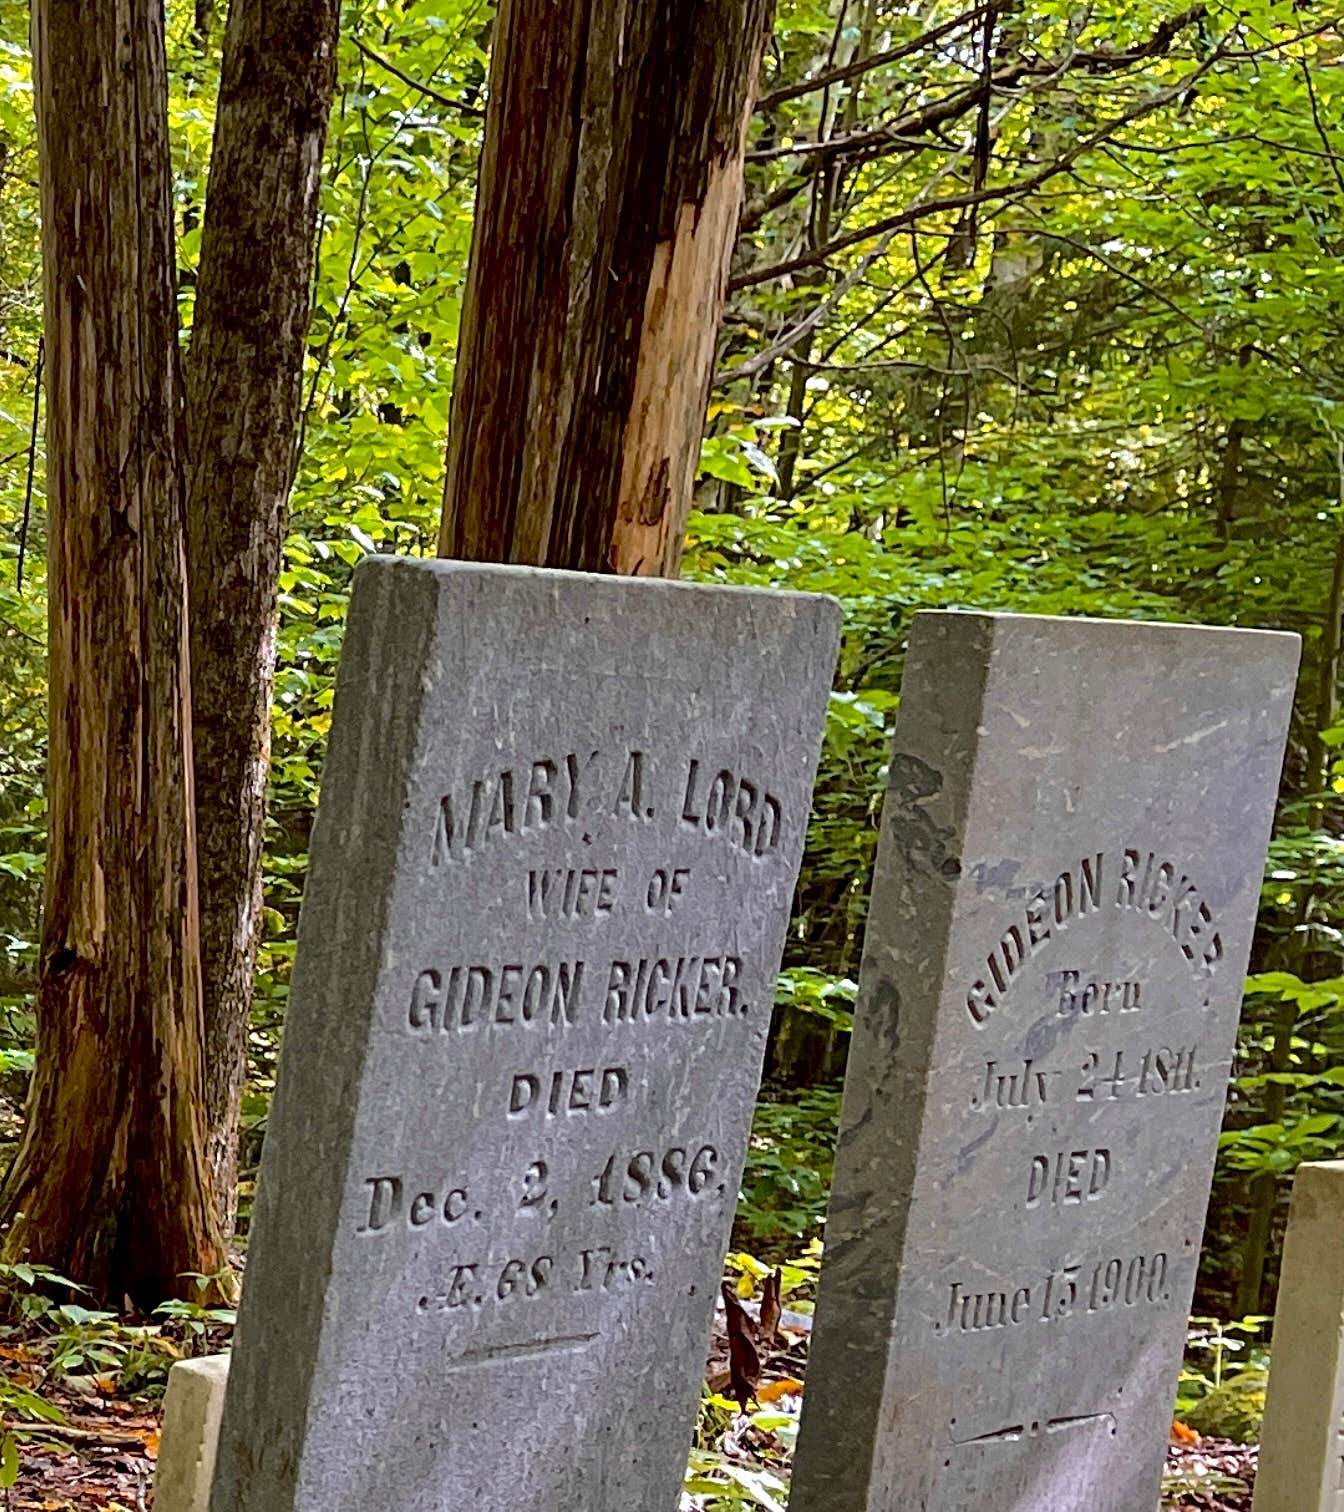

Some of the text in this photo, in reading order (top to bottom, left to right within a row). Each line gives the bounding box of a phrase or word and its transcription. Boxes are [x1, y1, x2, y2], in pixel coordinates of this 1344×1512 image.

[431, 750, 599, 867] MARY
[676, 759, 782, 862] LORD
[527, 868, 690, 918] WIFE OF
[967, 853, 1103, 1029] GIDEON
[408, 956, 748, 1033] GIDEON RICKER.
[507, 1067, 629, 1120] DIED
[969, 1059, 1062, 1121] July
[357, 1176, 482, 1236] Dec.
[1026, 1149, 1111, 1209] DIED
[933, 1282, 1030, 1336] June
[1039, 1265, 1081, 1321] 15
